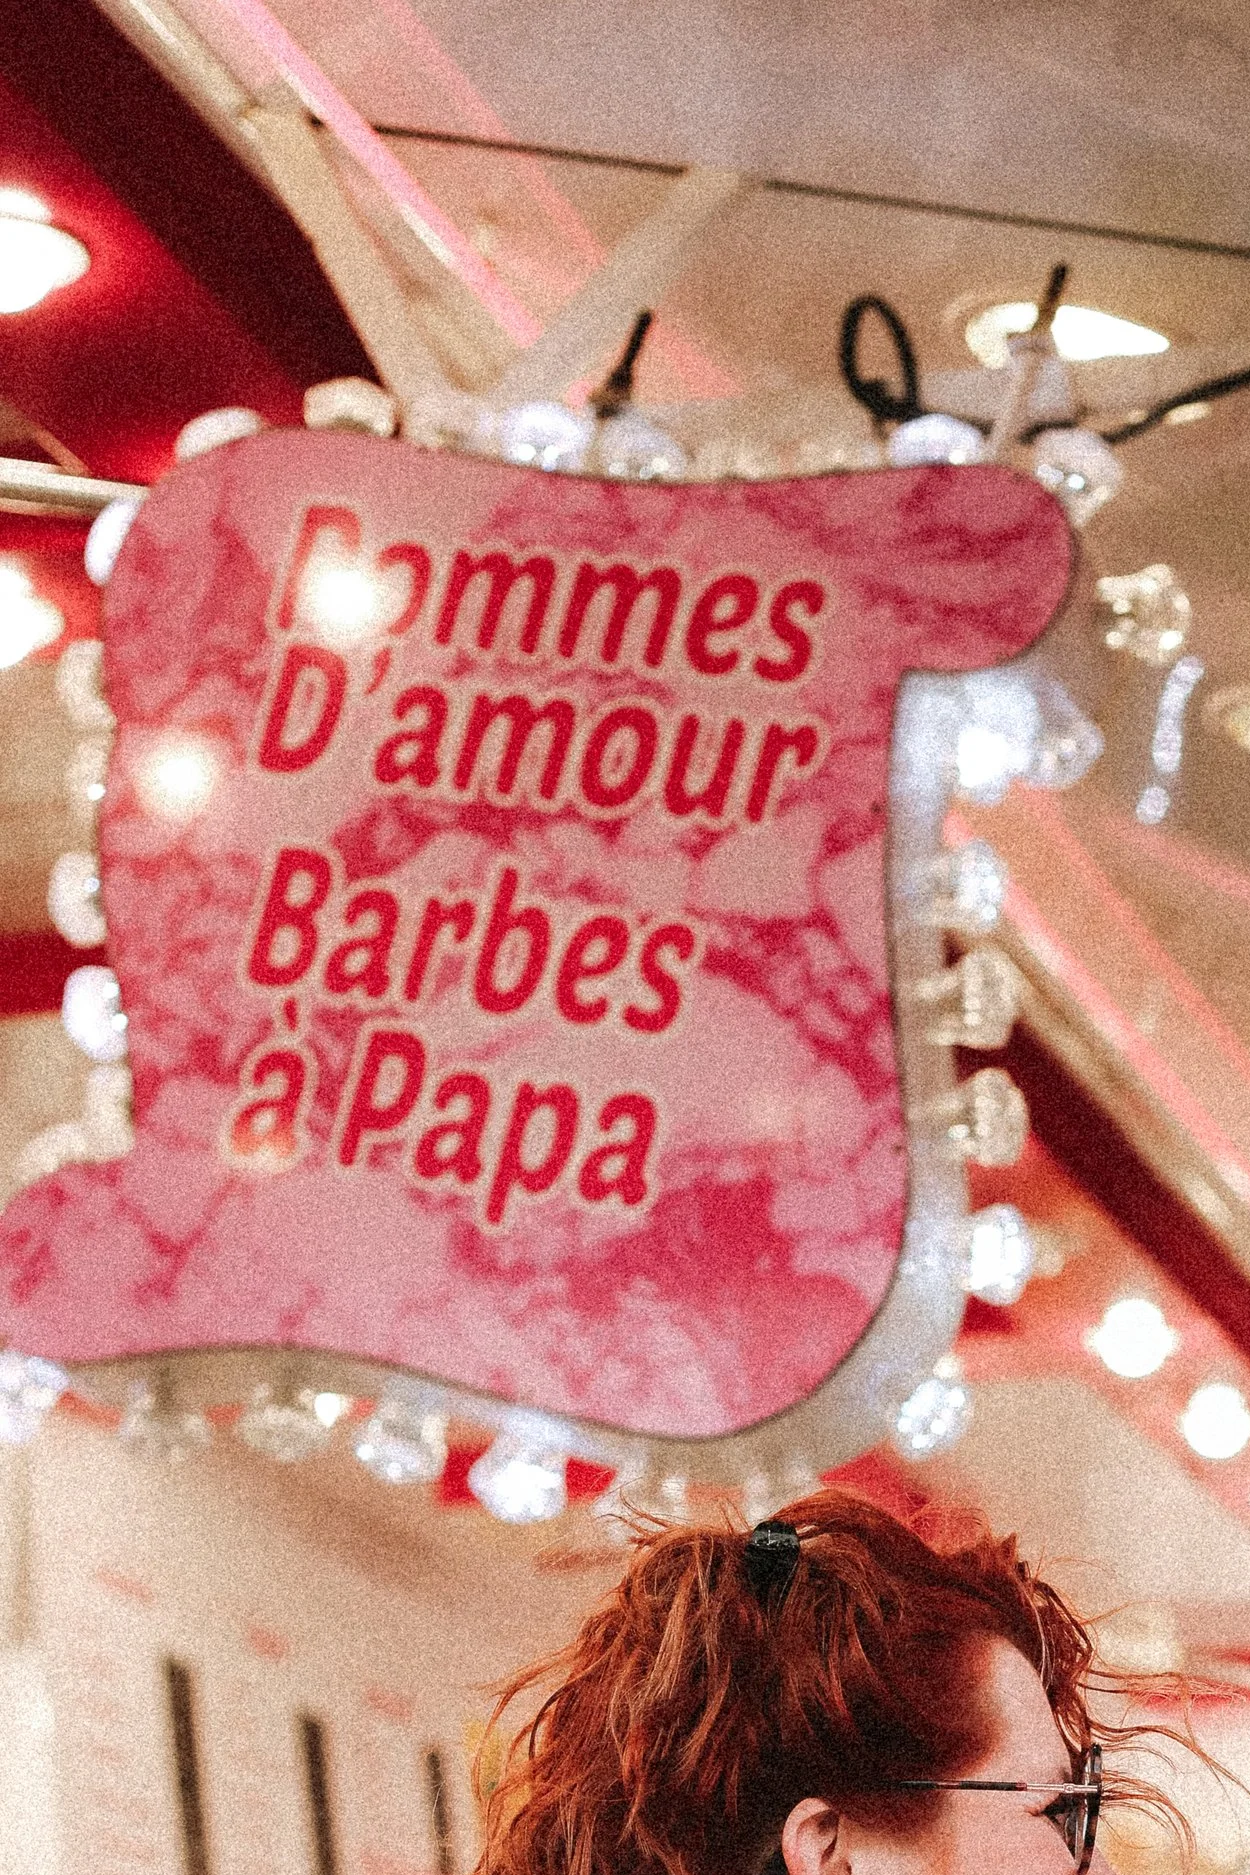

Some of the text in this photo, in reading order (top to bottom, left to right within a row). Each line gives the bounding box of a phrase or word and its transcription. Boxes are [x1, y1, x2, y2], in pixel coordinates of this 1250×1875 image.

[257, 644, 818, 823] D'amour
[248, 847, 695, 1033] Barbes
[337, 1030, 657, 1225] Papa
